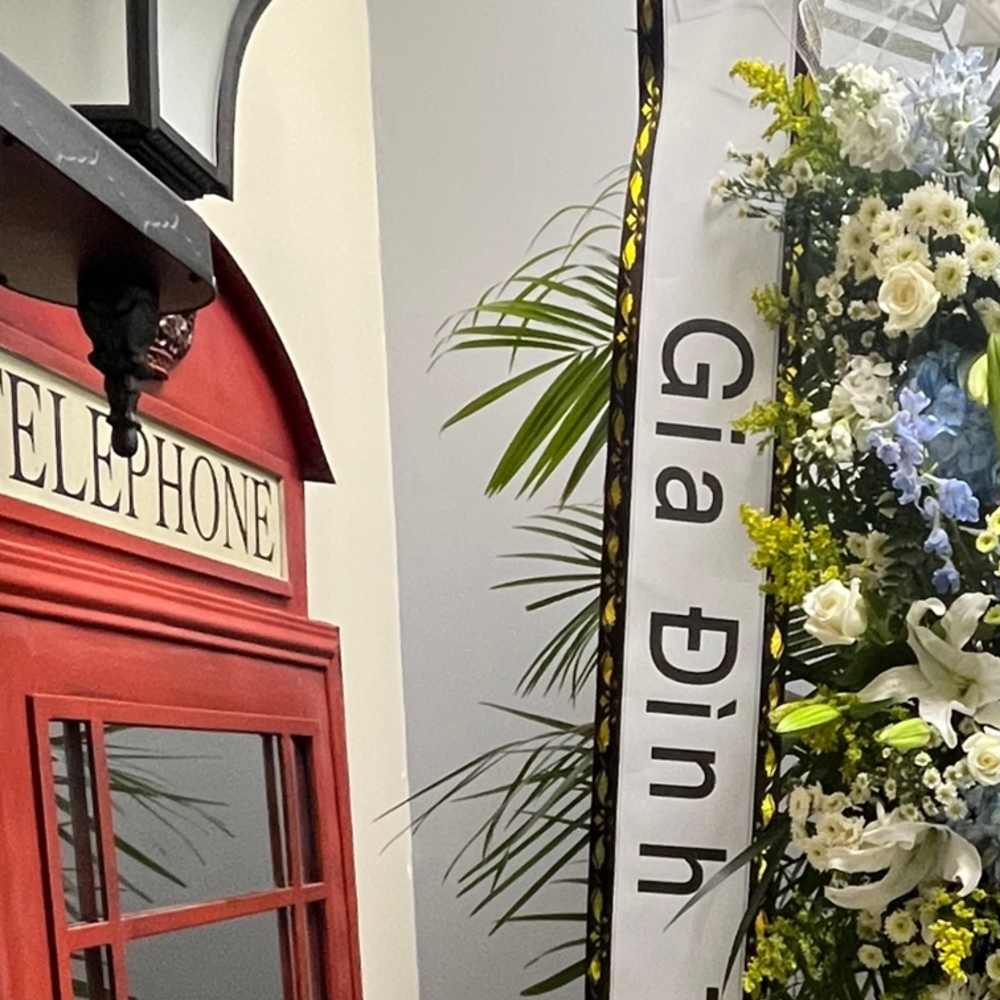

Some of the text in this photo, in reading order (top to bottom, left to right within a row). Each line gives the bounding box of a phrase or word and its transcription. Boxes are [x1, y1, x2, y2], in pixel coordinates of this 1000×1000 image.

[0, 368, 275, 562] ELEPHONE
[656, 319, 754, 523] Gia
[638, 607, 739, 894] Đình
